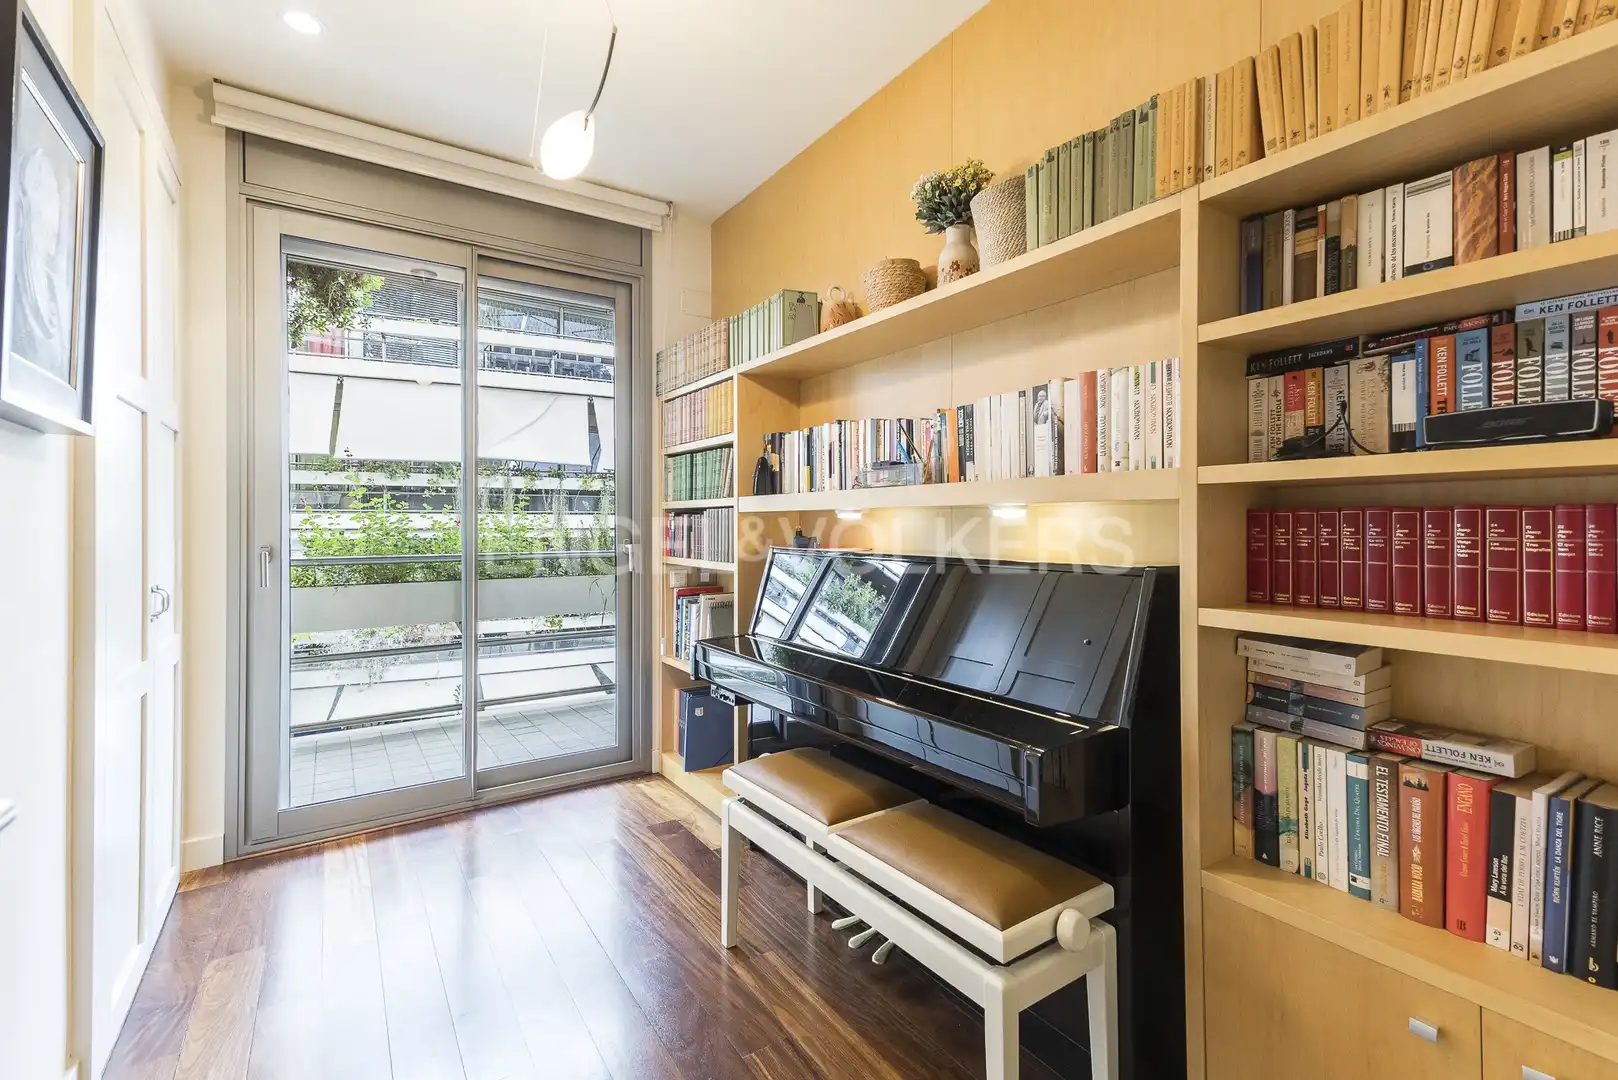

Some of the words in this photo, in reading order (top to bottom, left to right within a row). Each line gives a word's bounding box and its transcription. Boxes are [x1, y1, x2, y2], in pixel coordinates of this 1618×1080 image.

[1539, 303, 1563, 314] KEN
[1568, 294, 1618, 310] FOLLETT
[1250, 361, 1266, 372] KEN
[1269, 354, 1302, 367] FOLLETT
[1437, 346, 1448, 364] KEN
[1437, 365, 1448, 395] FOLLETT
[1492, 359, 1514, 407] FOLLE
[1517, 356, 1542, 404] FOLLE
[1544, 351, 1569, 402] FOLLE
[1572, 347, 1596, 399] FOLLE
[1598, 347, 1618, 401] FOLLE
[1461, 363, 1483, 411] FOLLE
[1377, 739, 1405, 751] WINGS
[1406, 746, 1421, 755] ON
[1424, 744, 1466, 759] FOLLETT
[1469, 753, 1491, 763] KEN
[1376, 765, 1389, 776] EL
[1376, 779, 1389, 832] TESTAMENTO
[1456, 783, 1473, 814] ENGAÑO
[1518, 816, 1527, 843] COETZEE
[1593, 816, 1604, 833] RICE
[1377, 832, 1389, 857] FINAL
[1593, 834, 1603, 858] ANNE
[1410, 864, 1422, 880] WOOD
[1491, 858, 1500, 878] Lawson
[1552, 865, 1561, 886] KURTÉN
[1552, 887, 1561, 904] BJÖRN
